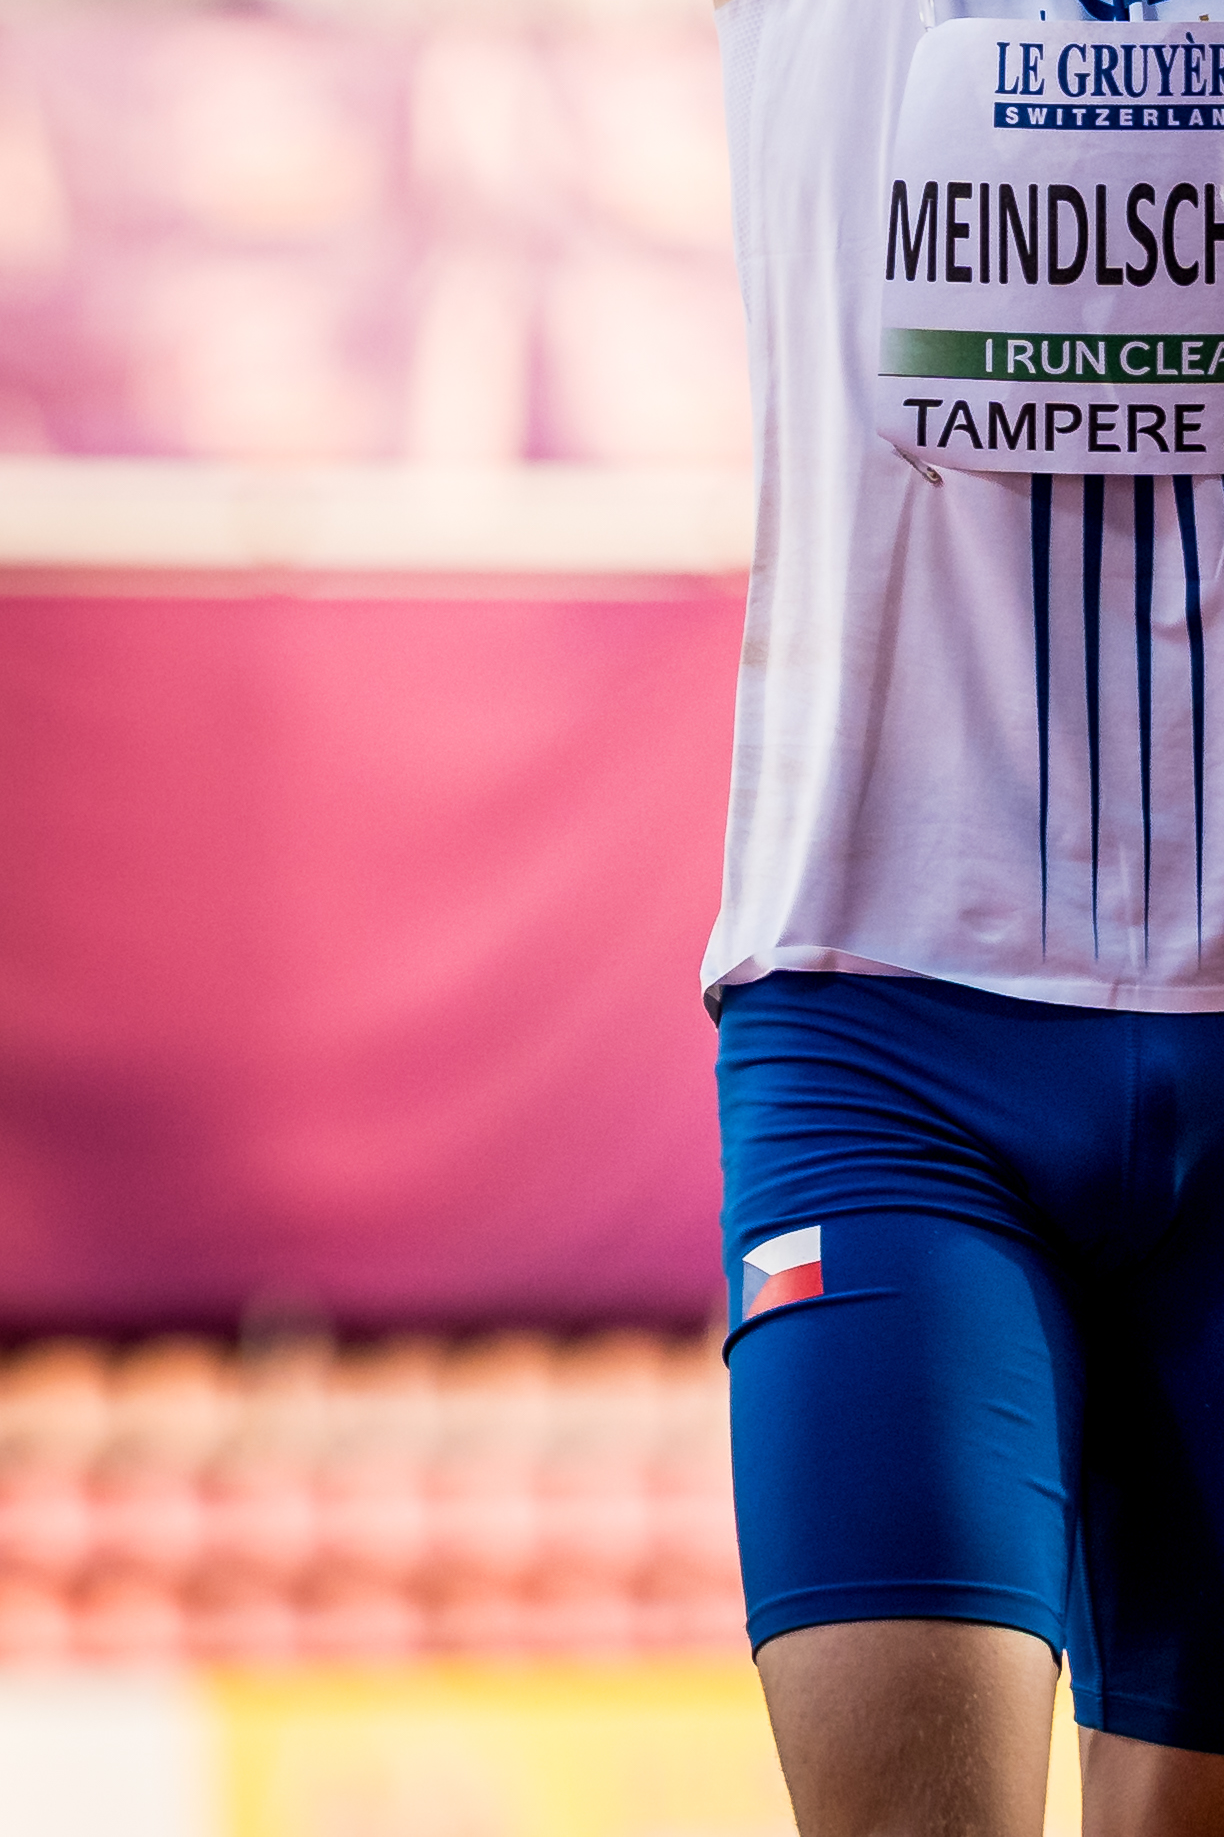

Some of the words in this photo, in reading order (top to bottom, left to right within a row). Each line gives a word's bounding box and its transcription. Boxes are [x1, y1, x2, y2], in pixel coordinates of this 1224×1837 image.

[994, 41, 1046, 96] LE
[984, 337, 994, 373] I
[1006, 339, 1107, 376] RUN
[902, 398, 1207, 453] TAMPERE
